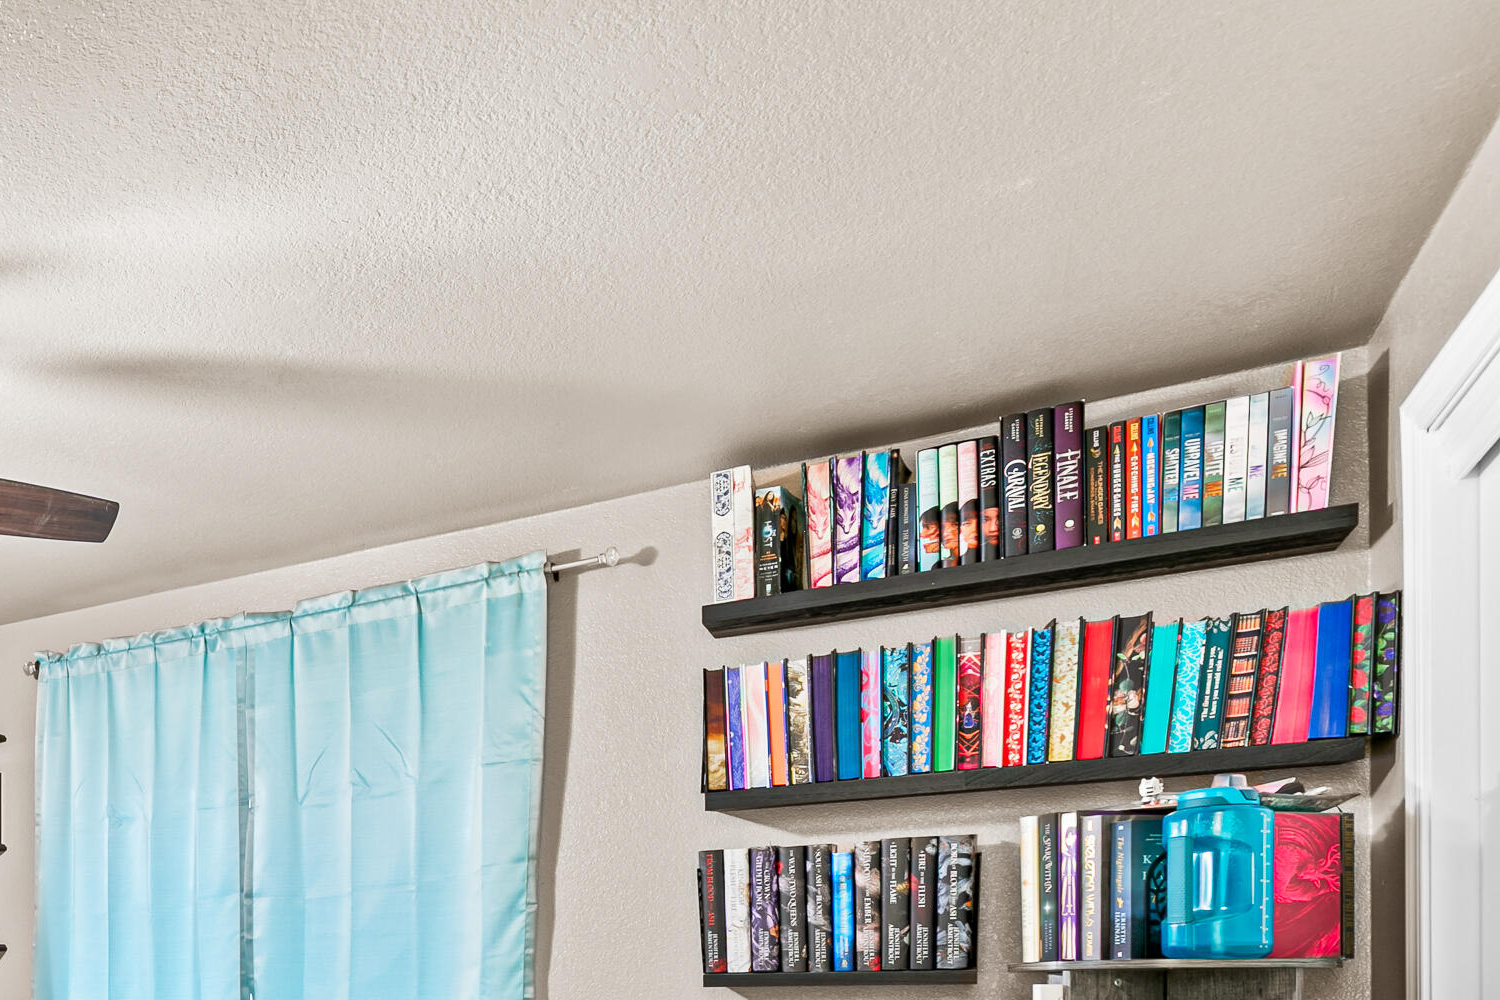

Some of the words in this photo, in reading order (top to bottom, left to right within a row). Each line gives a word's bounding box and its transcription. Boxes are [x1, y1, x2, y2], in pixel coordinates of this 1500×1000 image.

[1204, 440, 1224, 477] IGNITE
[1272, 428, 1288, 465] IMAGINE
[981, 449, 997, 489] EXTRAS
[1164, 447, 1180, 485] SHATTER
[1182, 438, 1201, 484] UNRAVEL
[1249, 464, 1264, 480] ME
[1271, 463, 1288, 480] ME
[1004, 459, 1027, 513] CARAVAL
[1028, 451, 1053, 510] LEGENDARY
[1056, 449, 1081, 503] FINALE
[1131, 455, 1139, 493] CATCHING
[1147, 452, 1155, 504] MOCKINGJAY
[1227, 477, 1244, 494] ME
[1182, 484, 1199, 501] ME
[1204, 480, 1222, 499] ME
[1131, 495, 1139, 514] FIRE
[889, 844, 898, 868] LIGHT
[950, 843, 959, 865] BORN
[1043, 835, 1053, 861] SPARK
[705, 854, 713, 875] FROM
[788, 857, 796, 874] WAR
[918, 854, 926, 871] FIRE
[1115, 852, 1125, 894] Nightingale
[789, 880, 797, 898] TWO
[815, 873, 823, 887] ASH
[950, 870, 959, 896] BLOOD
[1044, 861, 1053, 893] WITHIN
[889, 880, 898, 905] FLAME
[917, 885, 926, 908] FLESH
[787, 898, 798, 927] QUEENS
[863, 897, 872, 924] EMBER
[950, 905, 958, 920] ASH
